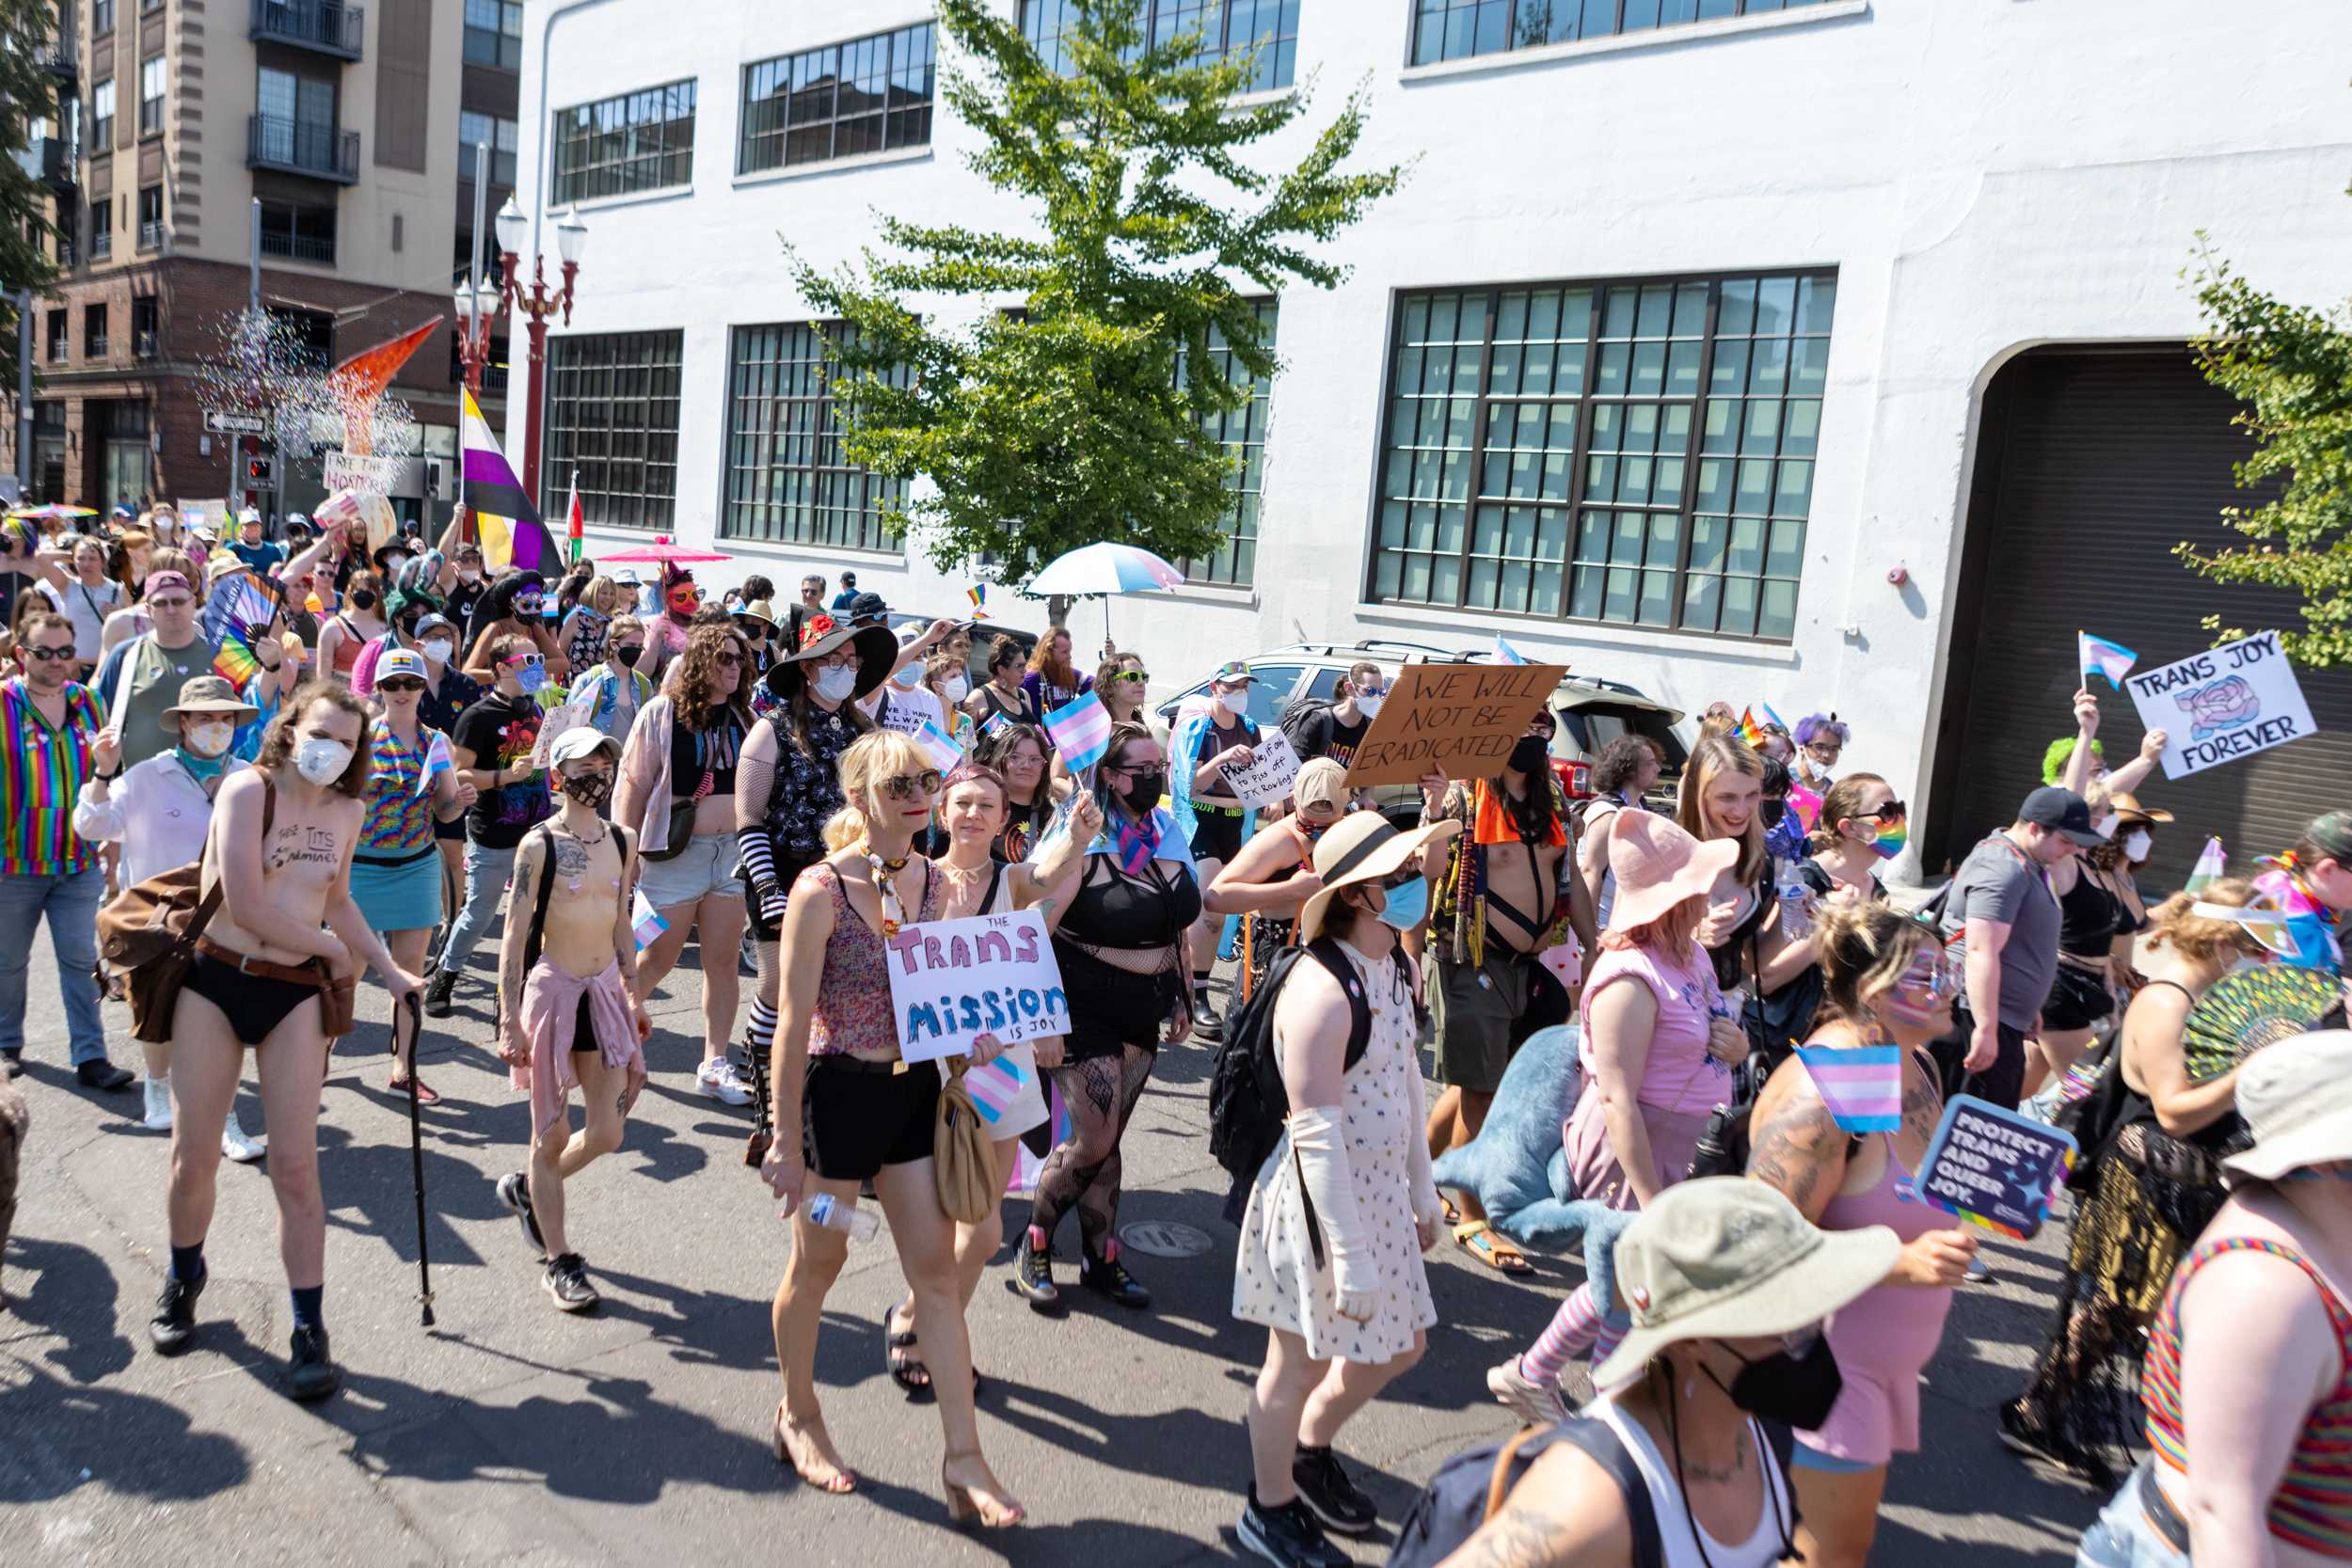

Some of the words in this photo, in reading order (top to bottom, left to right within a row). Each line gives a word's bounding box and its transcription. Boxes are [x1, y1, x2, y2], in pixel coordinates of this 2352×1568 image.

[328, 453, 356, 470] FREE
[362, 458, 383, 470] THE
[2133, 657, 2216, 697] TRANS
[2225, 634, 2274, 669] JOY
[1414, 673, 1469, 701] WE
[1473, 673, 1536, 700] WILL
[913, 710, 931, 720] HAVE
[1401, 706, 1472, 734] NOT
[1472, 706, 1514, 727] BE
[1357, 735, 1514, 770] ERADICATED
[2182, 716, 2297, 769] FOREVER
[1236, 779, 1248, 788] to
[1273, 756, 1285, 771] off
[1261, 774, 1292, 792] Rowling
[306, 827, 335, 847] TITS
[986, 916, 1010, 928] THE
[1010, 1026, 1023, 1040] IS
[1029, 1018, 1057, 1032] JOY
[1950, 1127, 2022, 1166] TRANS
[1956, 1112, 2053, 1160] PROTECT
[1941, 1145, 1992, 1173] AND
[1928, 1176, 1975, 1206] JOY.
[1936, 1160, 2007, 1199] QUEER
